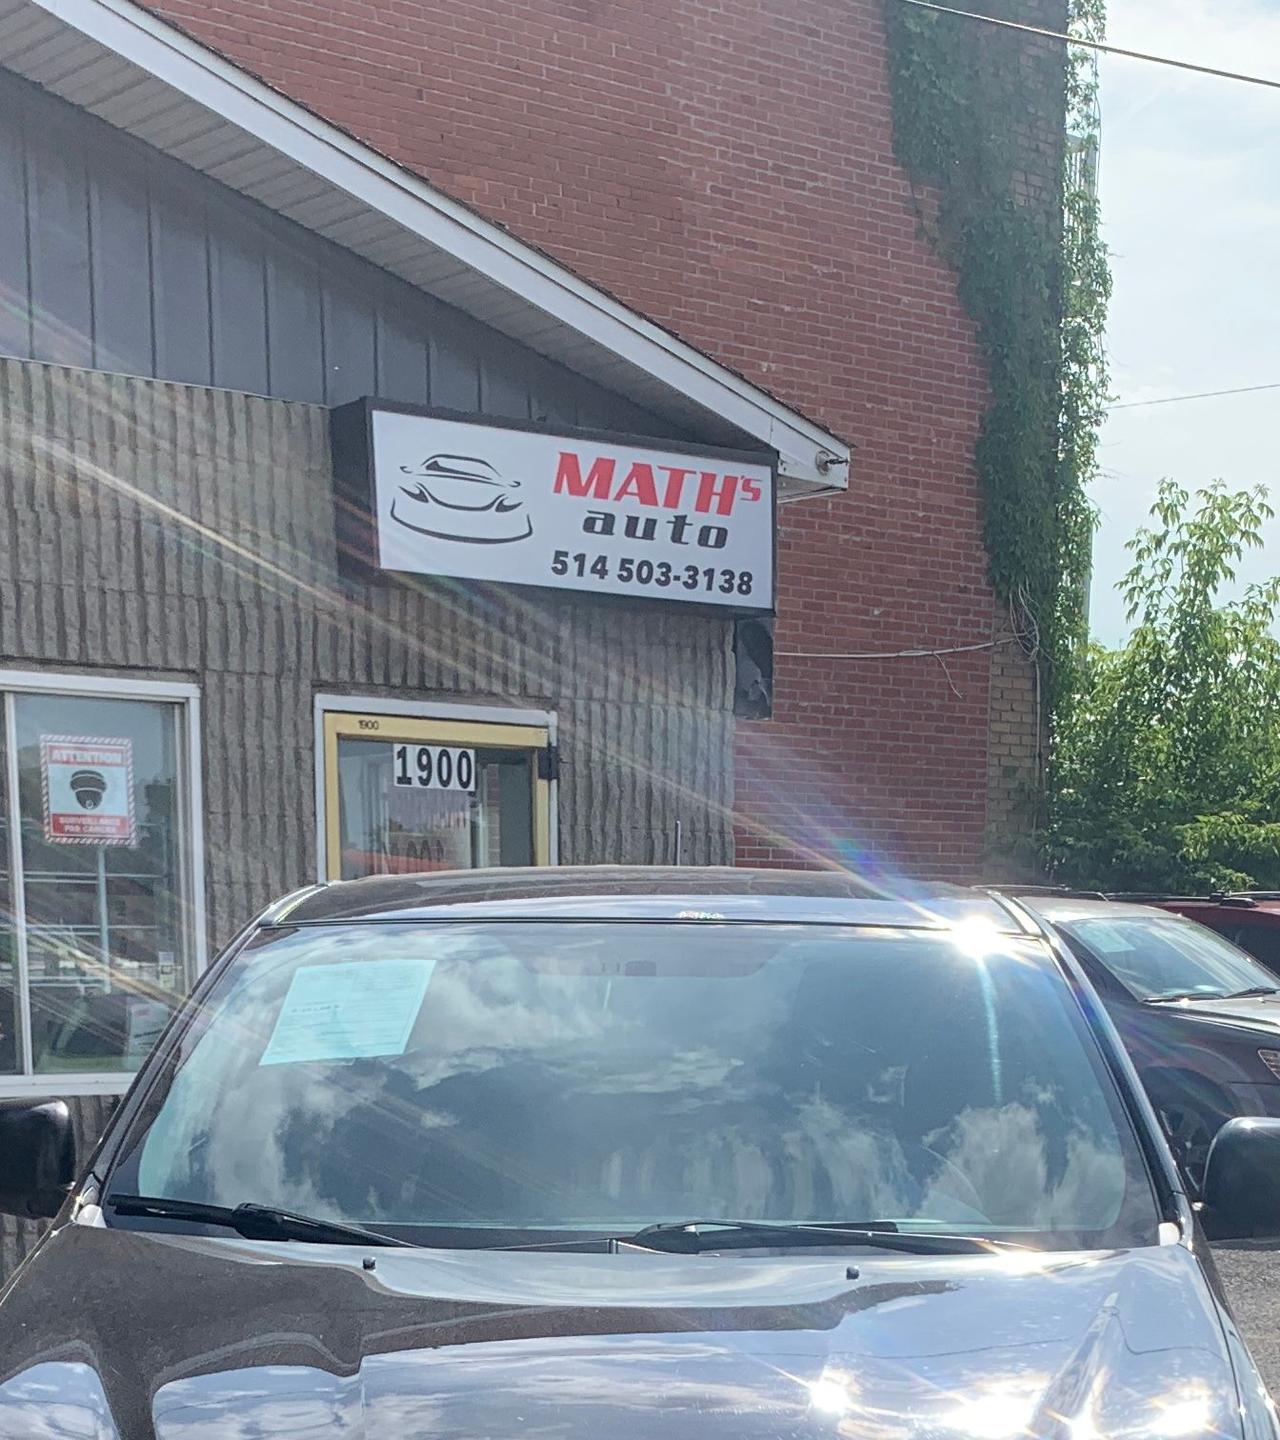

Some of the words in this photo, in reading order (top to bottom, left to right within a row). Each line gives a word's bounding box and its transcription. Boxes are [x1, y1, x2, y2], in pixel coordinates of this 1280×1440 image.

[582, 509, 729, 550] auto
[551, 550, 609, 581] 514
[617, 557, 754, 596] 503-3138
[358, 719, 380, 731] 1900
[396, 745, 473, 790] 1900
